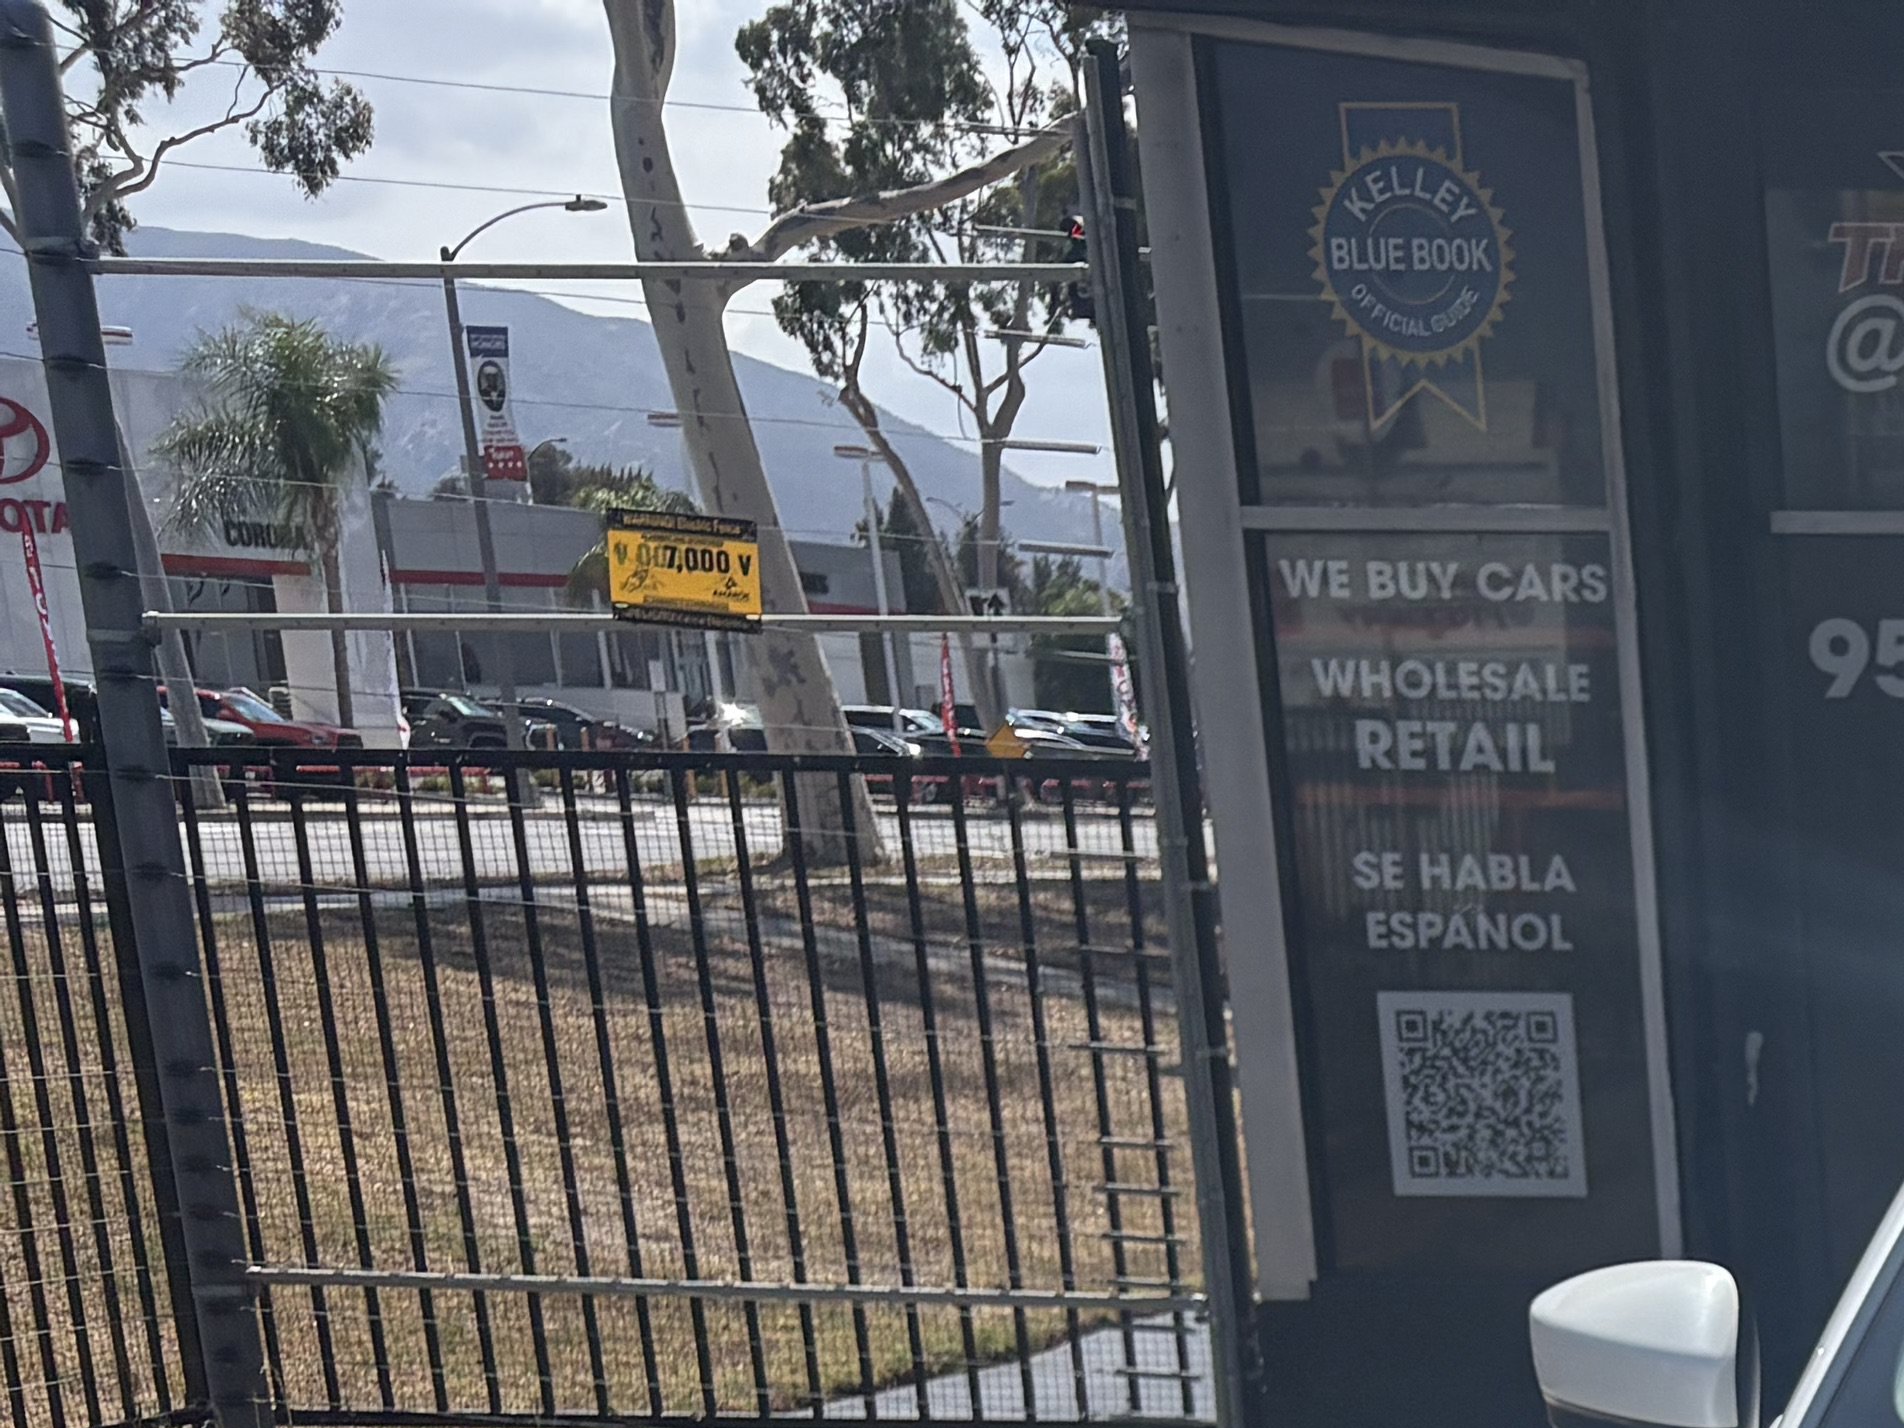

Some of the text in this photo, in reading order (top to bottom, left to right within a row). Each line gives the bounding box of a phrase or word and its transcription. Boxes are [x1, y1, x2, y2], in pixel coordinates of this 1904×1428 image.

[1343, 165, 1478, 223] KELLEY
[1330, 237, 1492, 272] BLUE BOOK
[1351, 283, 1480, 337] OFFICIAL GUIDE
[1279, 559, 1608, 604] WE BUY CARS
[1310, 657, 1592, 703] WHOLESALE
[1354, 718, 1556, 775] RETAIL
[1353, 850, 1577, 893] SE HABLA
